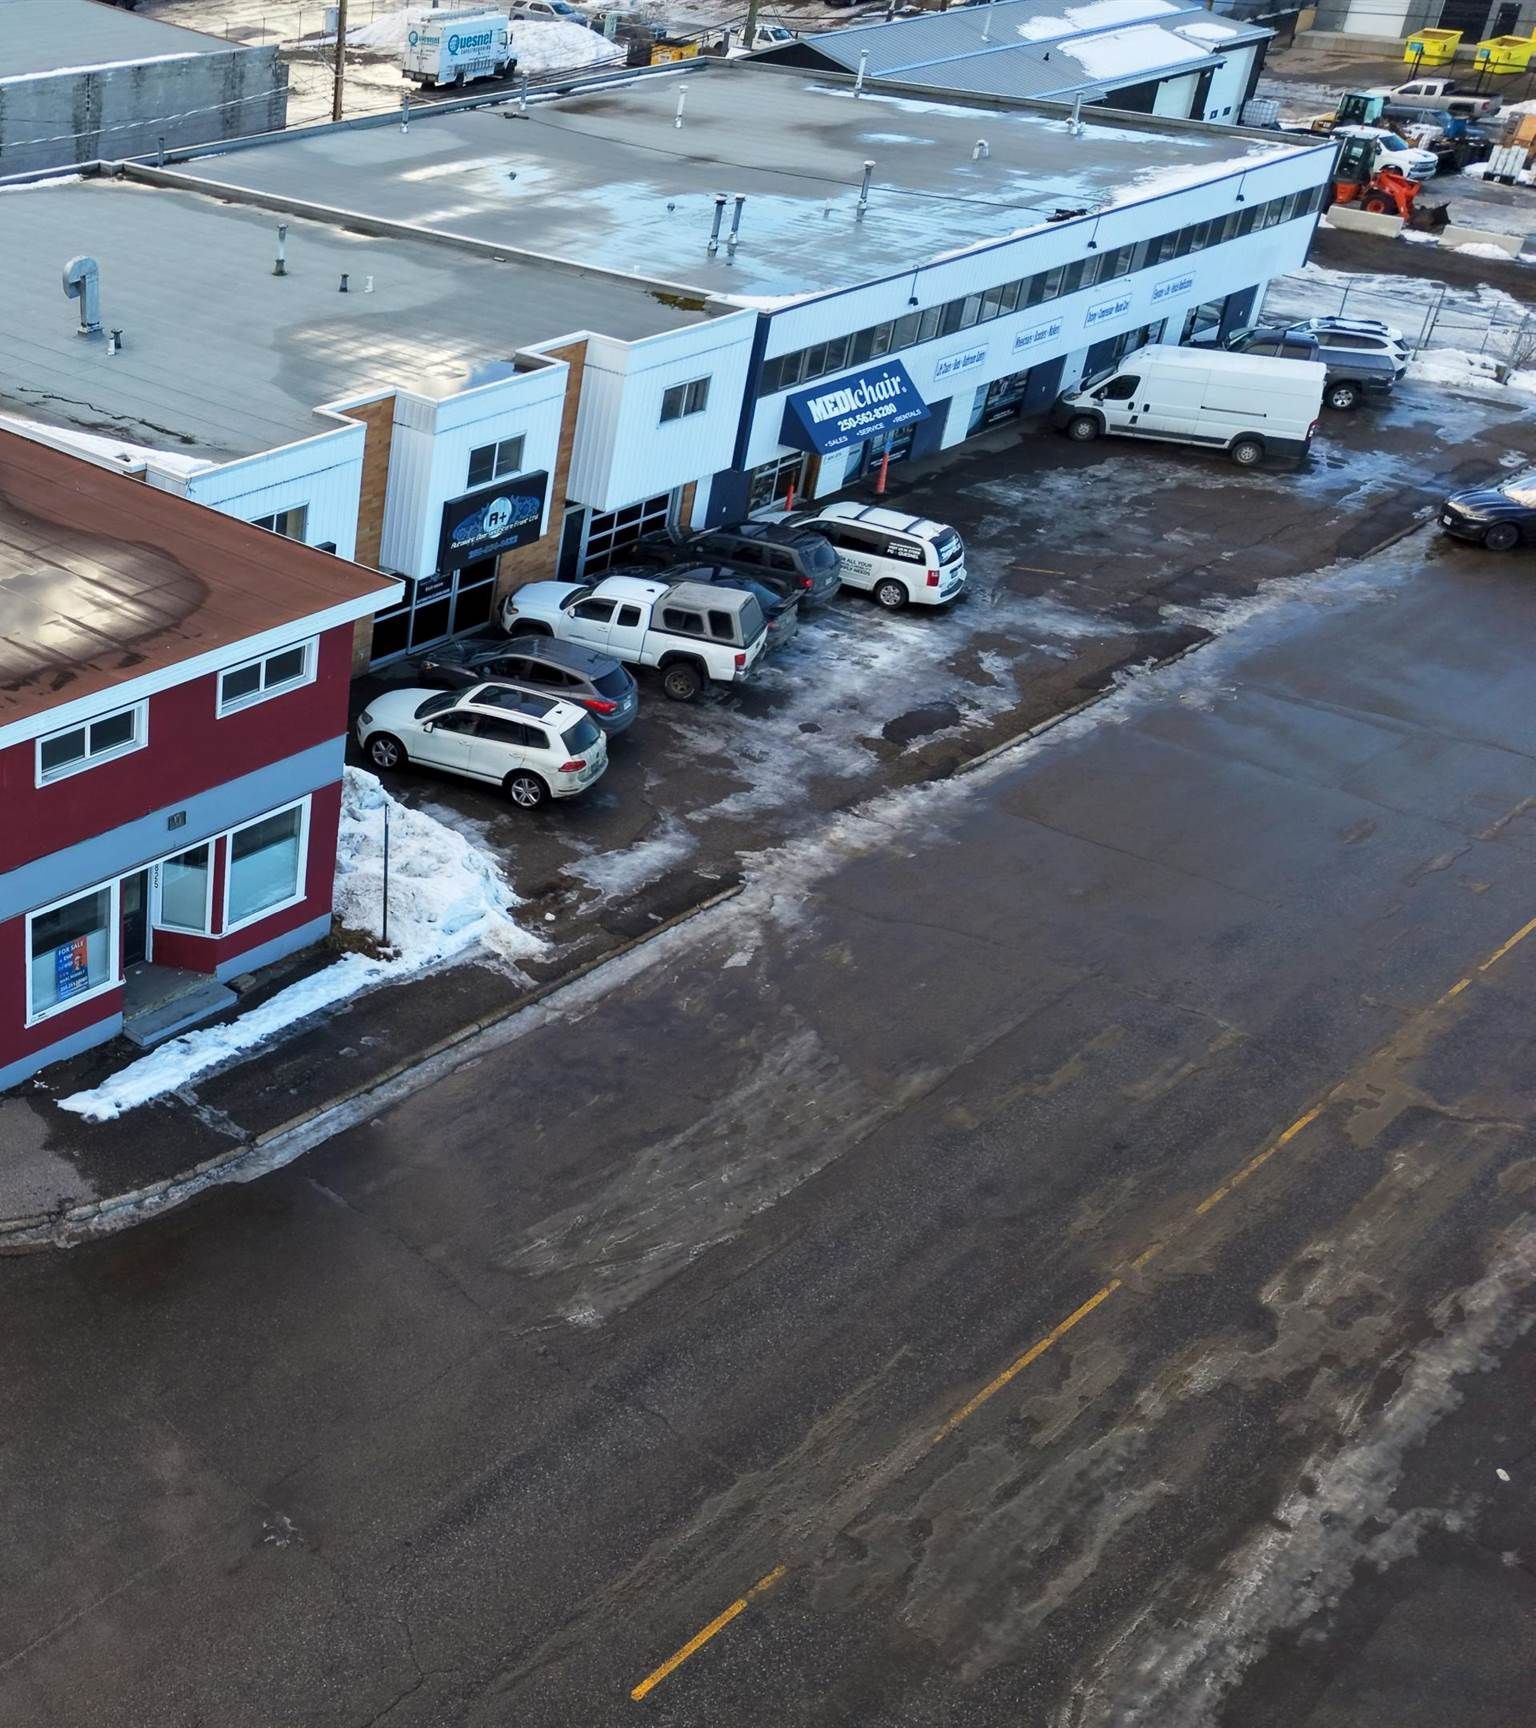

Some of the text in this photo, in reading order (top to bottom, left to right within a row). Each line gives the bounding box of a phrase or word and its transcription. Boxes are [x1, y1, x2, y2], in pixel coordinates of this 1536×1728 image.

[448, 30, 493, 55] Quesnel
[826, 409, 922, 447] SALES SERVICE RENTALS
[837, 402, 897, 432] 250-562-8280
[489, 512, 507, 527] A+
[58, 941, 84, 956] FOR SALE
